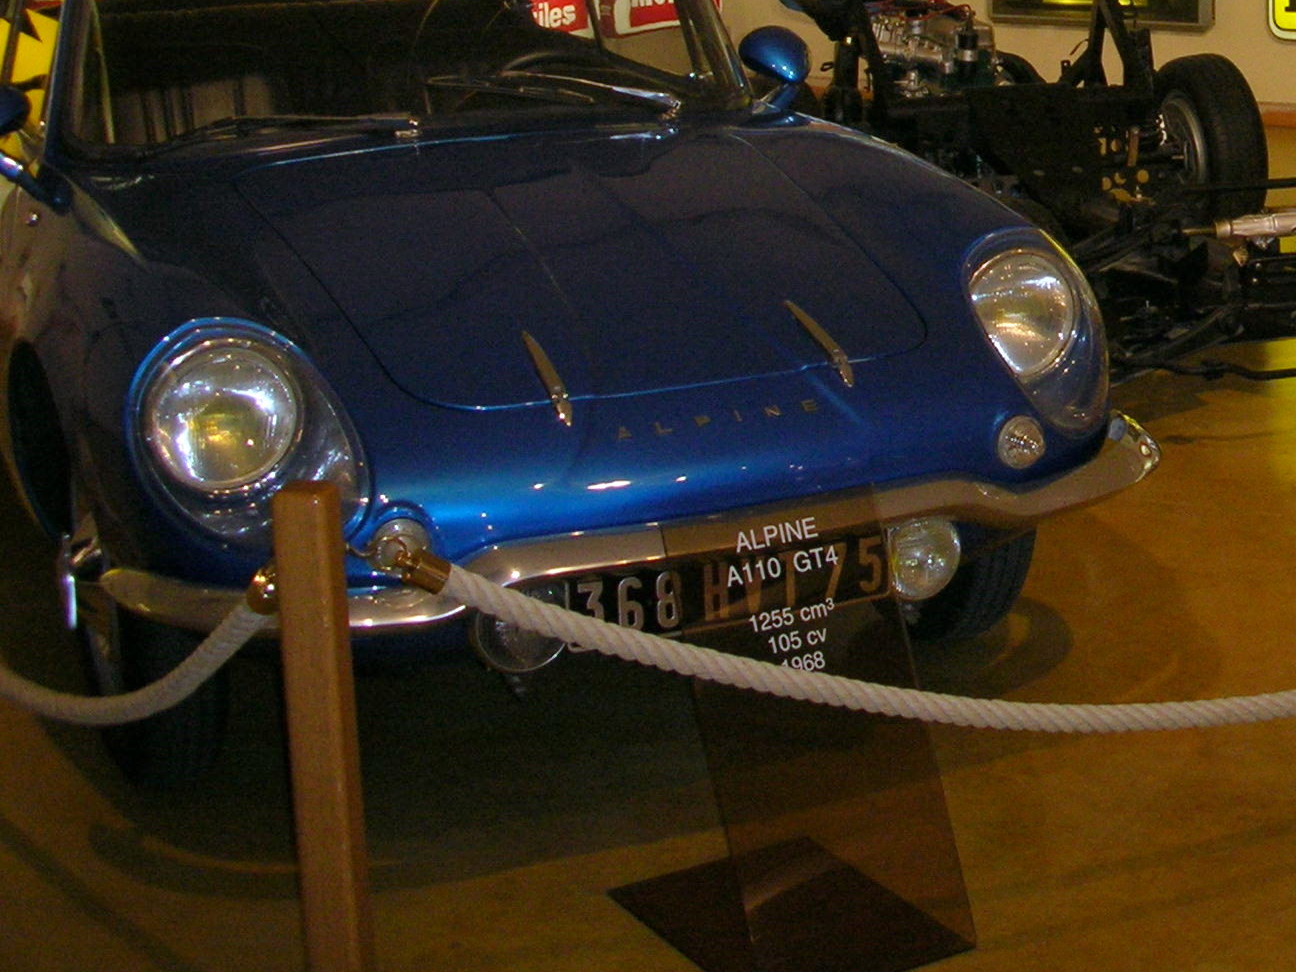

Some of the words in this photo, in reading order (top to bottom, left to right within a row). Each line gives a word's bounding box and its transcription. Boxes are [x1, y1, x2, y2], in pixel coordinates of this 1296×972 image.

[615, 398, 819, 441] ALPINE
[735, 516, 819, 554] ALPINE
[726, 556, 782, 589] A110
[793, 544, 839, 574] GT4
[749, 605, 795, 633] 1255
[767, 630, 803, 655] 105
[806, 627, 828, 647] cv
